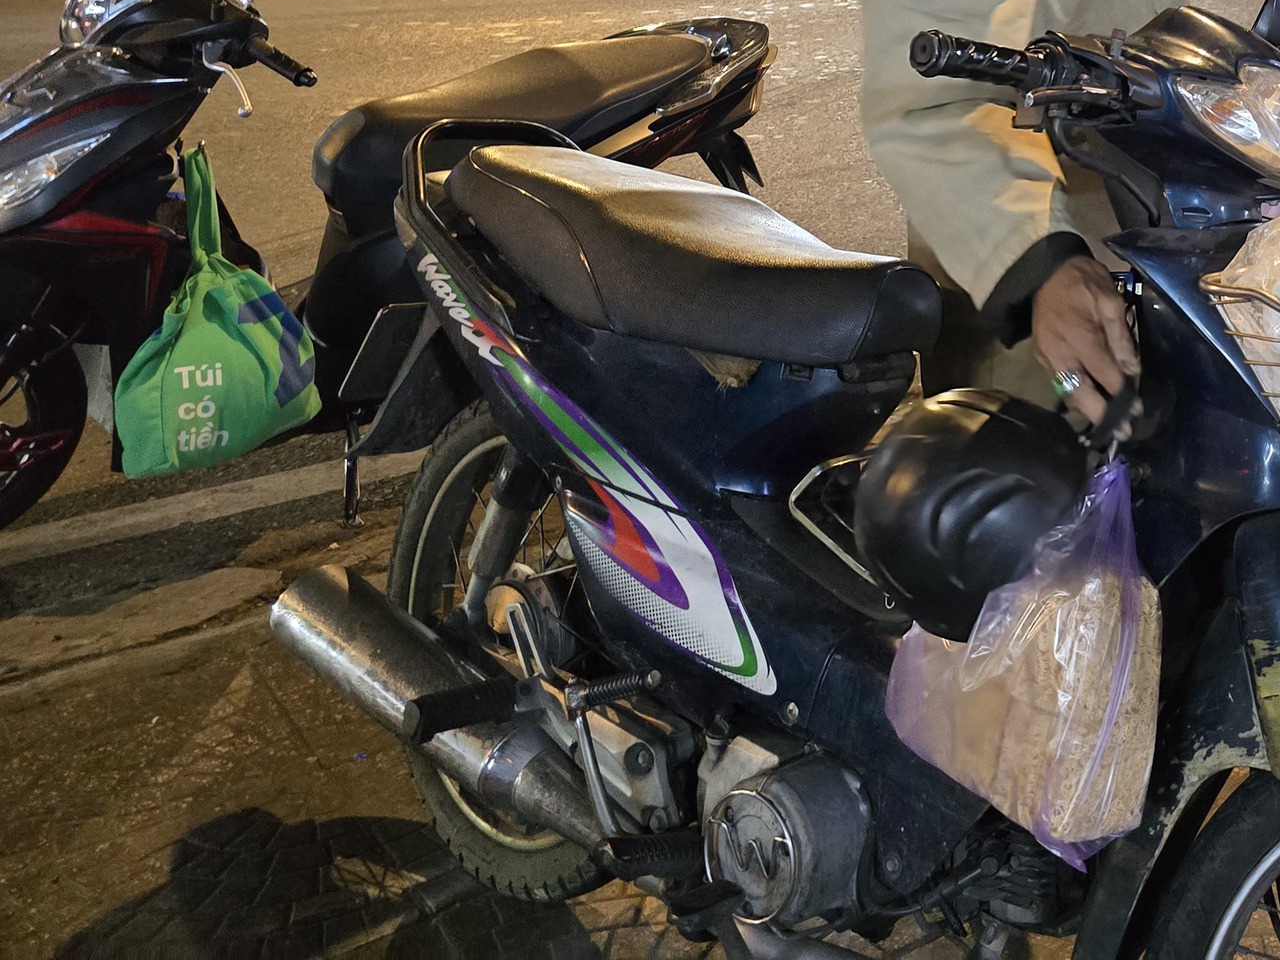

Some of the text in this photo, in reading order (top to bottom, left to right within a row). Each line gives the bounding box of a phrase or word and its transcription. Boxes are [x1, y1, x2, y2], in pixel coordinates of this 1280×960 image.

[417, 253, 474, 328] Wave
[173, 362, 223, 389] Túi
[178, 394, 216, 420] có
[177, 421, 229, 452] tiền
